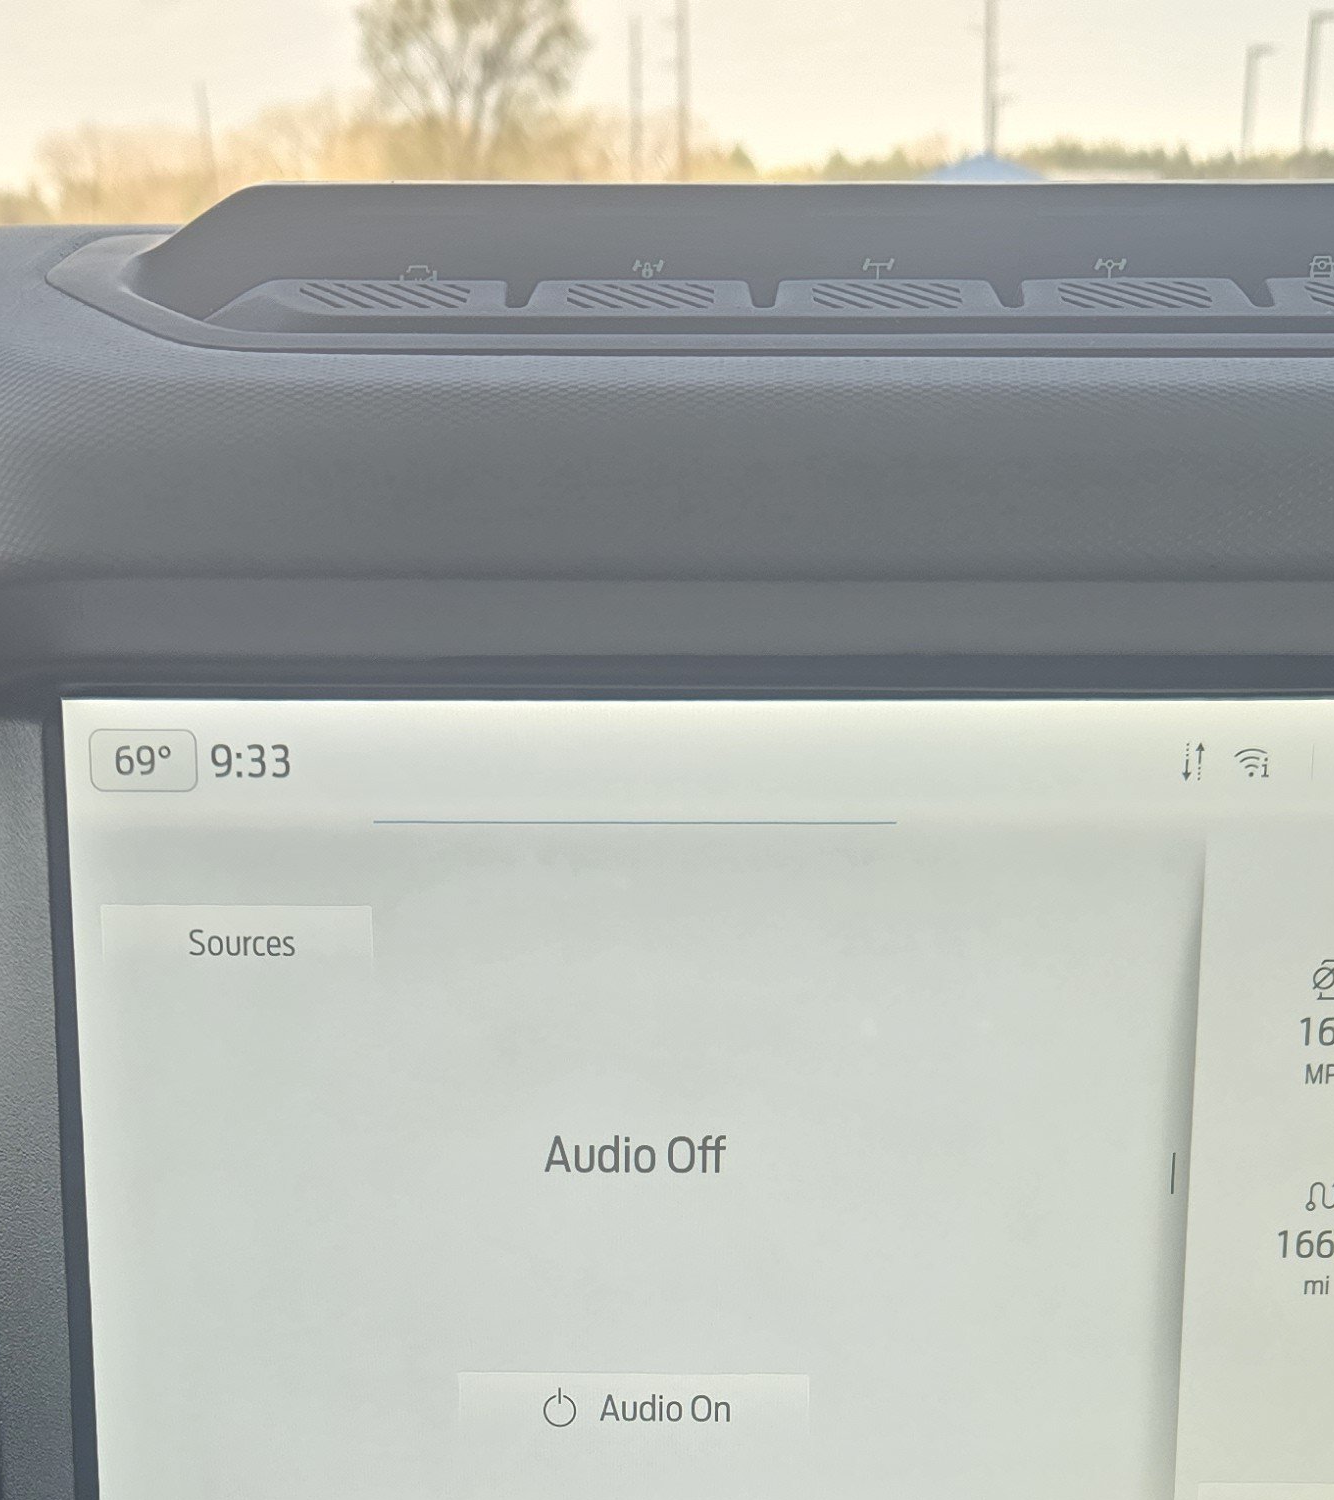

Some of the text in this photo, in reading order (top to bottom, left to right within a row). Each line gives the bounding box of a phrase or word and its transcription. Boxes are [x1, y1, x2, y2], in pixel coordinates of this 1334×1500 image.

[116, 744, 290, 778] 69° 9:33
[189, 929, 295, 956] Sources
[545, 1135, 726, 1173] Audio Off
[1304, 1276, 1329, 1295] mi
[600, 1394, 730, 1422] Audio On
